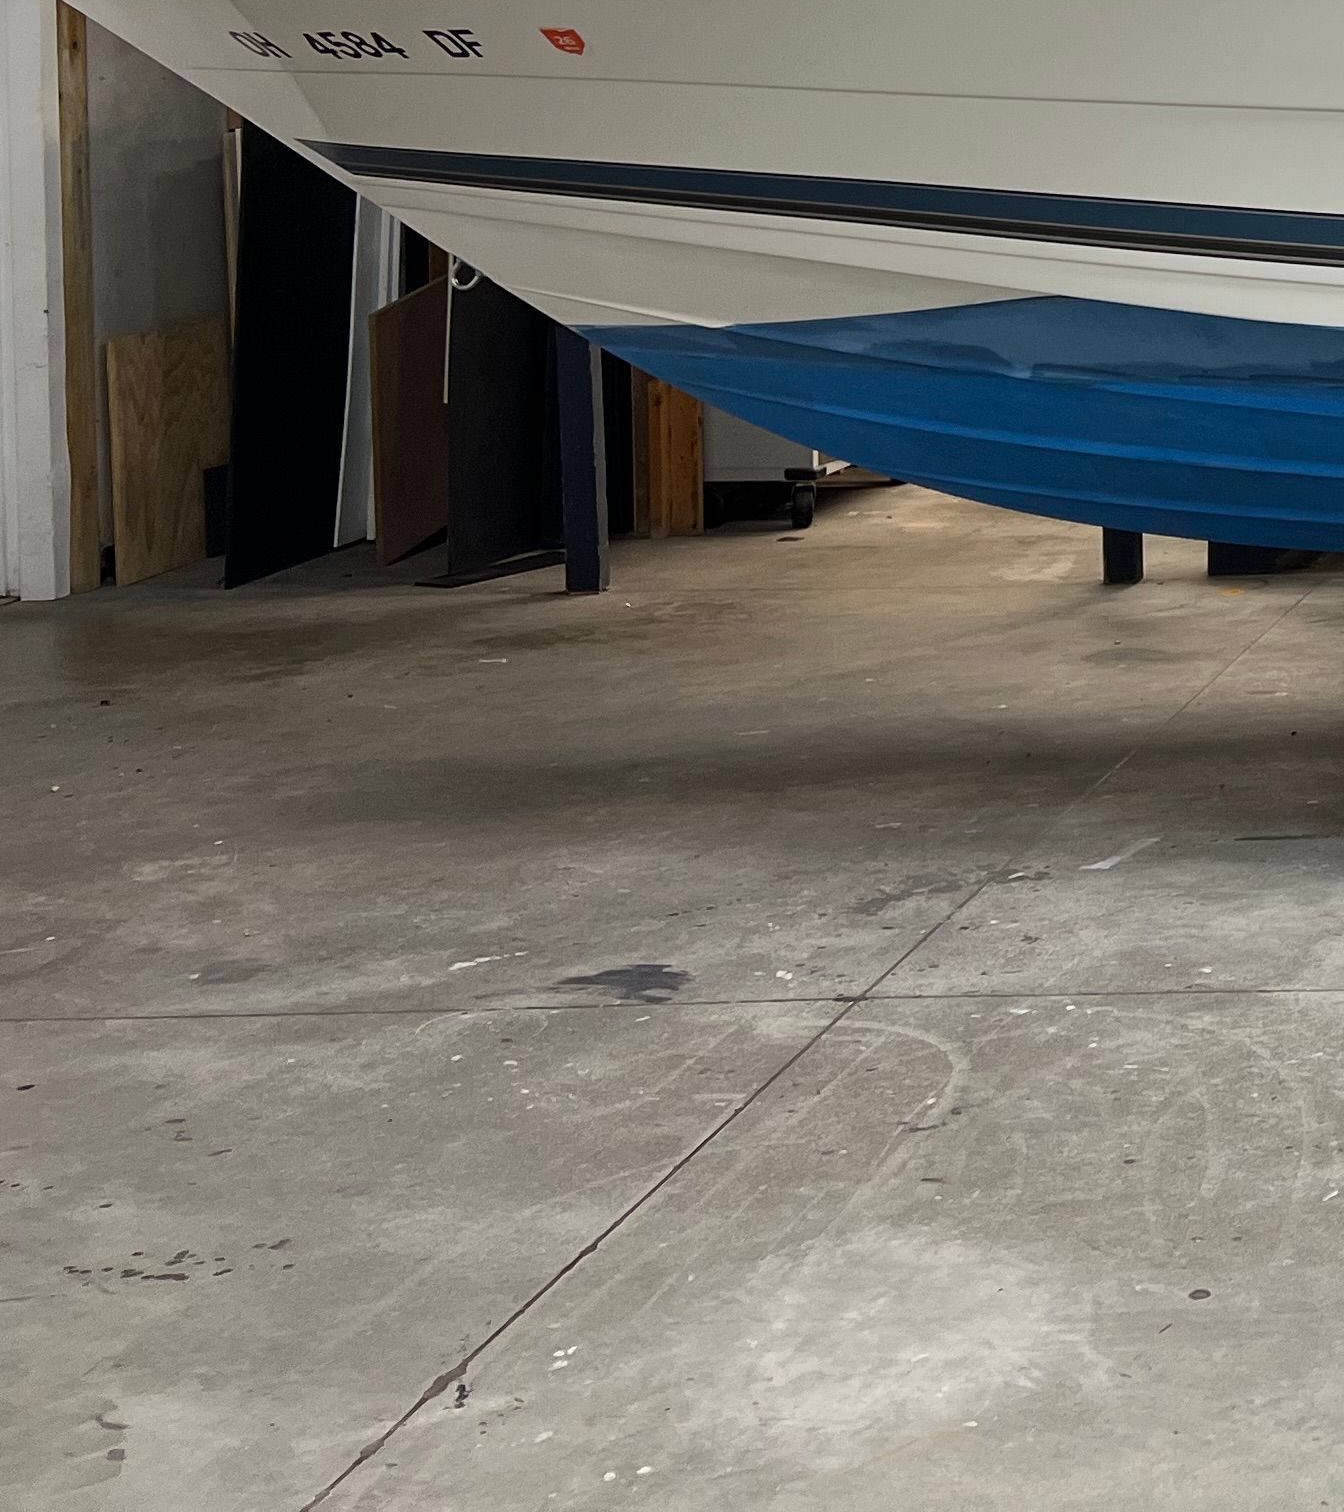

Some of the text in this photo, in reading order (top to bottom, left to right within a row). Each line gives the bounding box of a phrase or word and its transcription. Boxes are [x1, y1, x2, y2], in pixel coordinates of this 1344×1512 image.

[229, 28, 484, 60] OH 4584 DF
